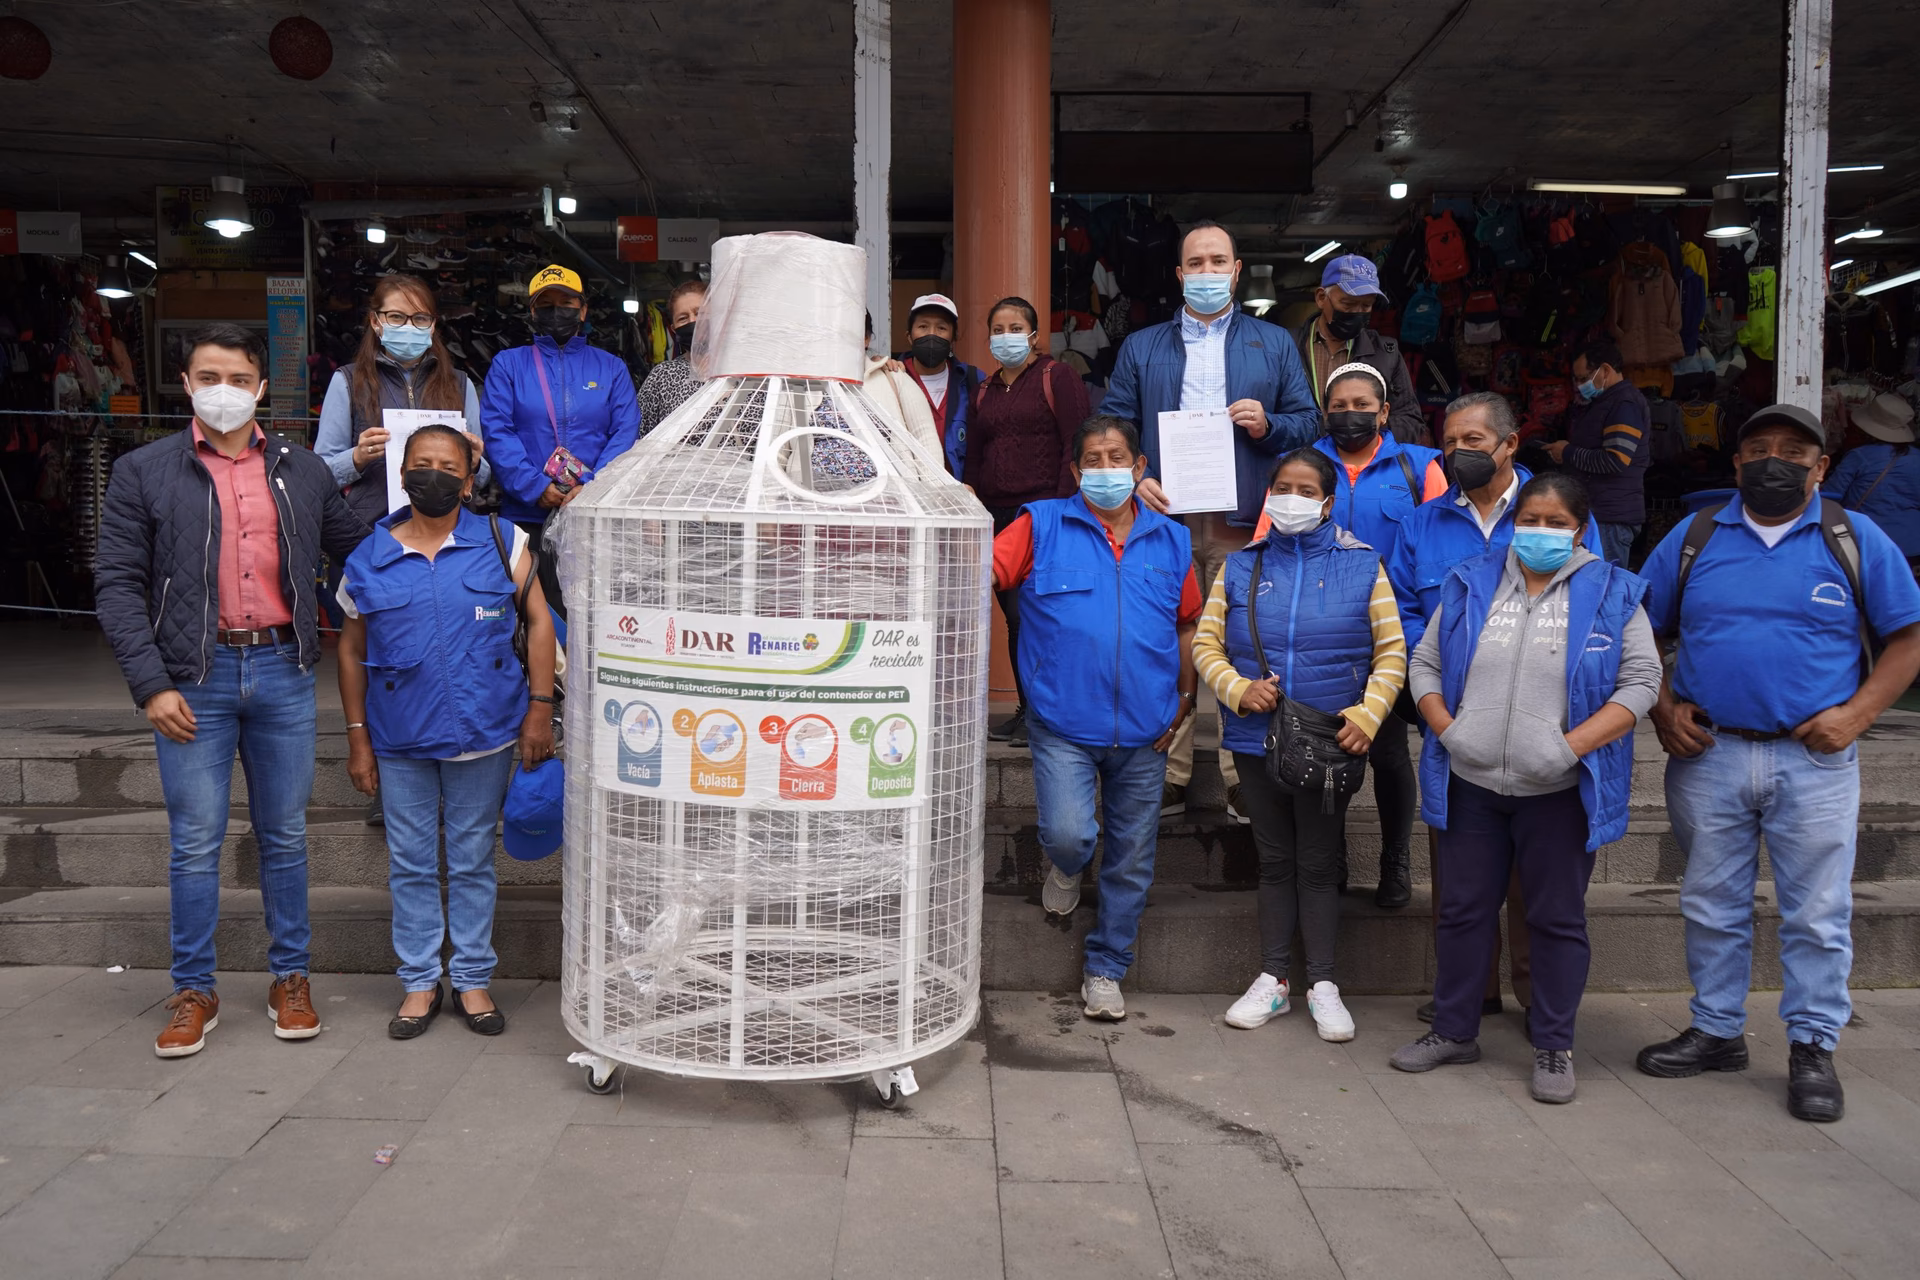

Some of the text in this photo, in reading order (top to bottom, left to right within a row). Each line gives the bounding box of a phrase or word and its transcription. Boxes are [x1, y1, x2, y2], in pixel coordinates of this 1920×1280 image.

[178, 187, 283, 204] RELERIA
[1484, 615, 1569, 628] OM PAN
[681, 629, 735, 653] DAR
[748, 632, 800, 655] RENAREC
[871, 629, 921, 647] DAR es
[1478, 631, 1513, 648] Calif
[870, 650, 924, 668] reciclar
[600, 671, 619, 683] Sigue
[620, 673, 631, 684] las
[632, 676, 674, 690] siguientes
[676, 681, 739, 696] instrucciones
[741, 688, 764, 698] para
[766, 689, 775, 697] el
[799, 690, 816, 699] del
[818, 690, 874, 700] contenedor
[875, 690, 887, 699] de
[888, 690, 905, 699] PET
[610, 705, 616, 718] 1
[680, 715, 690, 729] 2
[768, 721, 779, 735] 3
[858, 723, 868, 736] 4
[627, 762, 651, 779] Vacía
[697, 771, 739, 789] Aplasta
[791, 778, 825, 793] Cierra
[871, 775, 912, 793] Deposita
